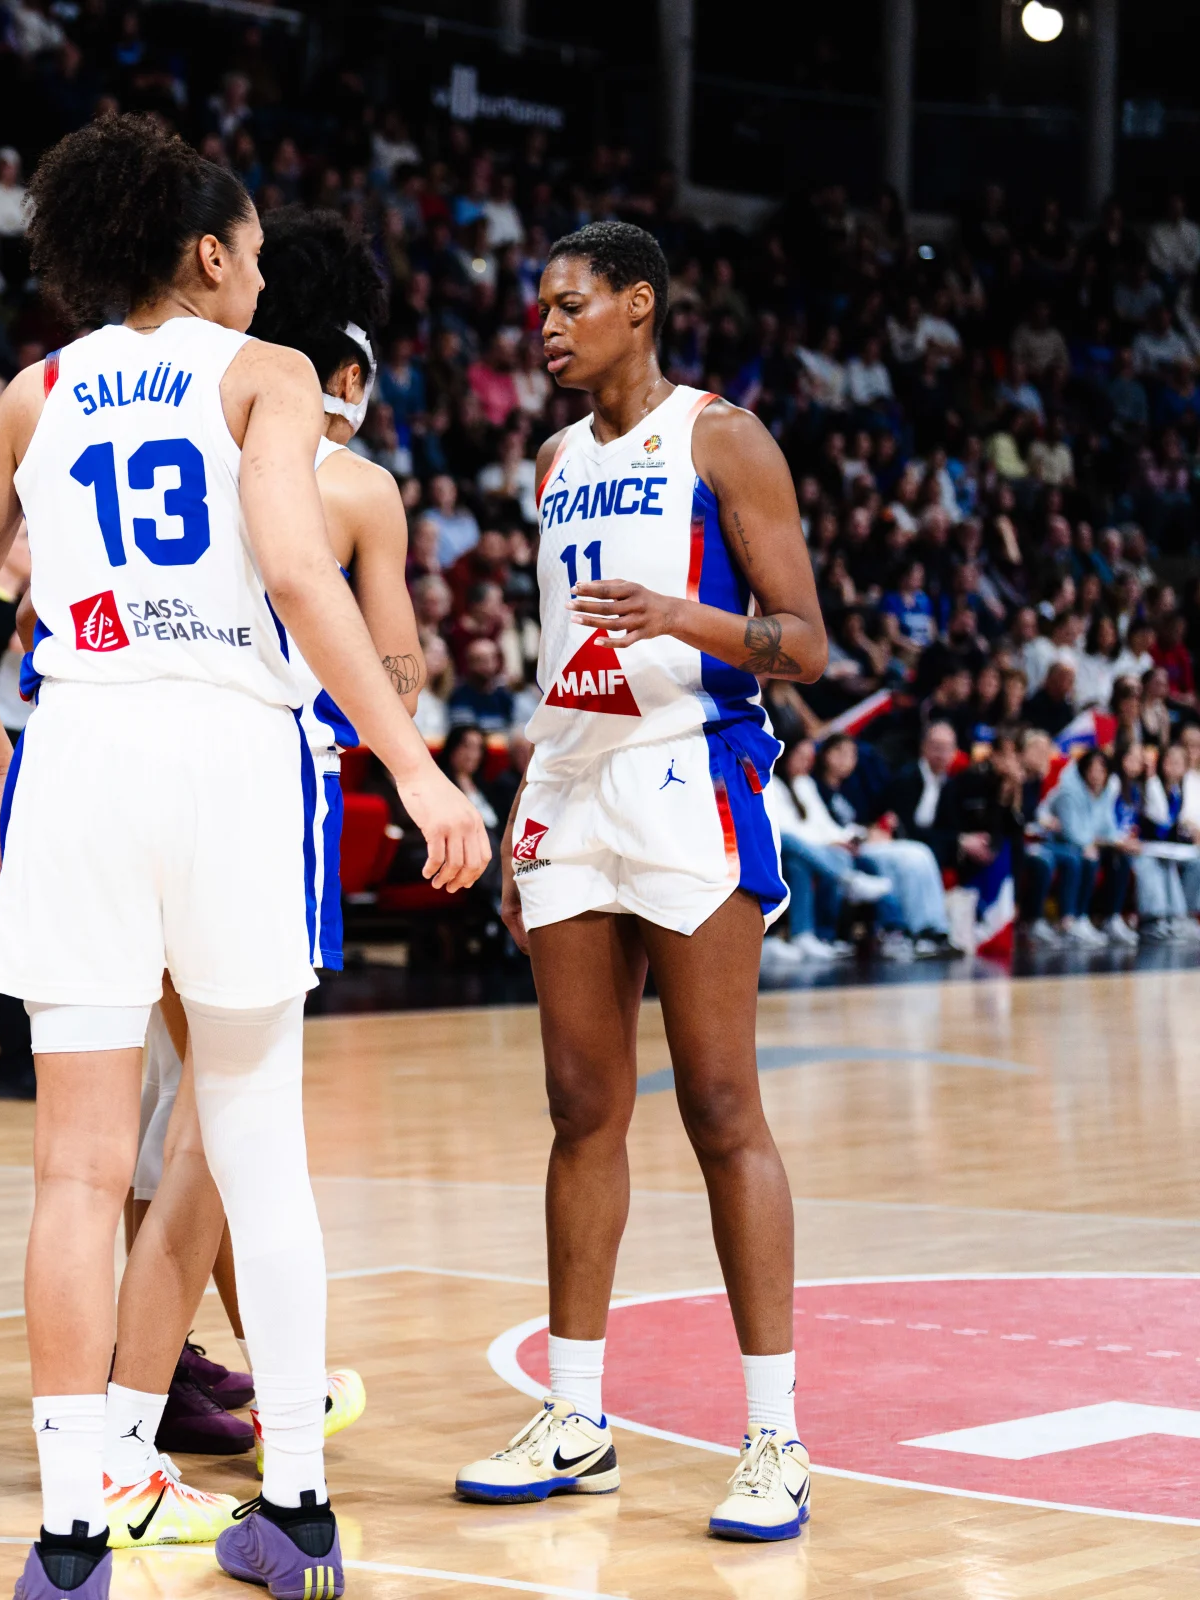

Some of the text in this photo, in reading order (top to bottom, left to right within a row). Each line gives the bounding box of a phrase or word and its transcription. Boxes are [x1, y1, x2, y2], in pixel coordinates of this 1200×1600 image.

[73, 361, 192, 415] SALAÜN
[69, 438, 211, 567] 13
[540, 476, 668, 534] FRANCE
[560, 540, 602, 600] 11
[127, 598, 200, 621] CASS
[133, 619, 252, 647] D'EARNE
[556, 668, 626, 698] MAIF
